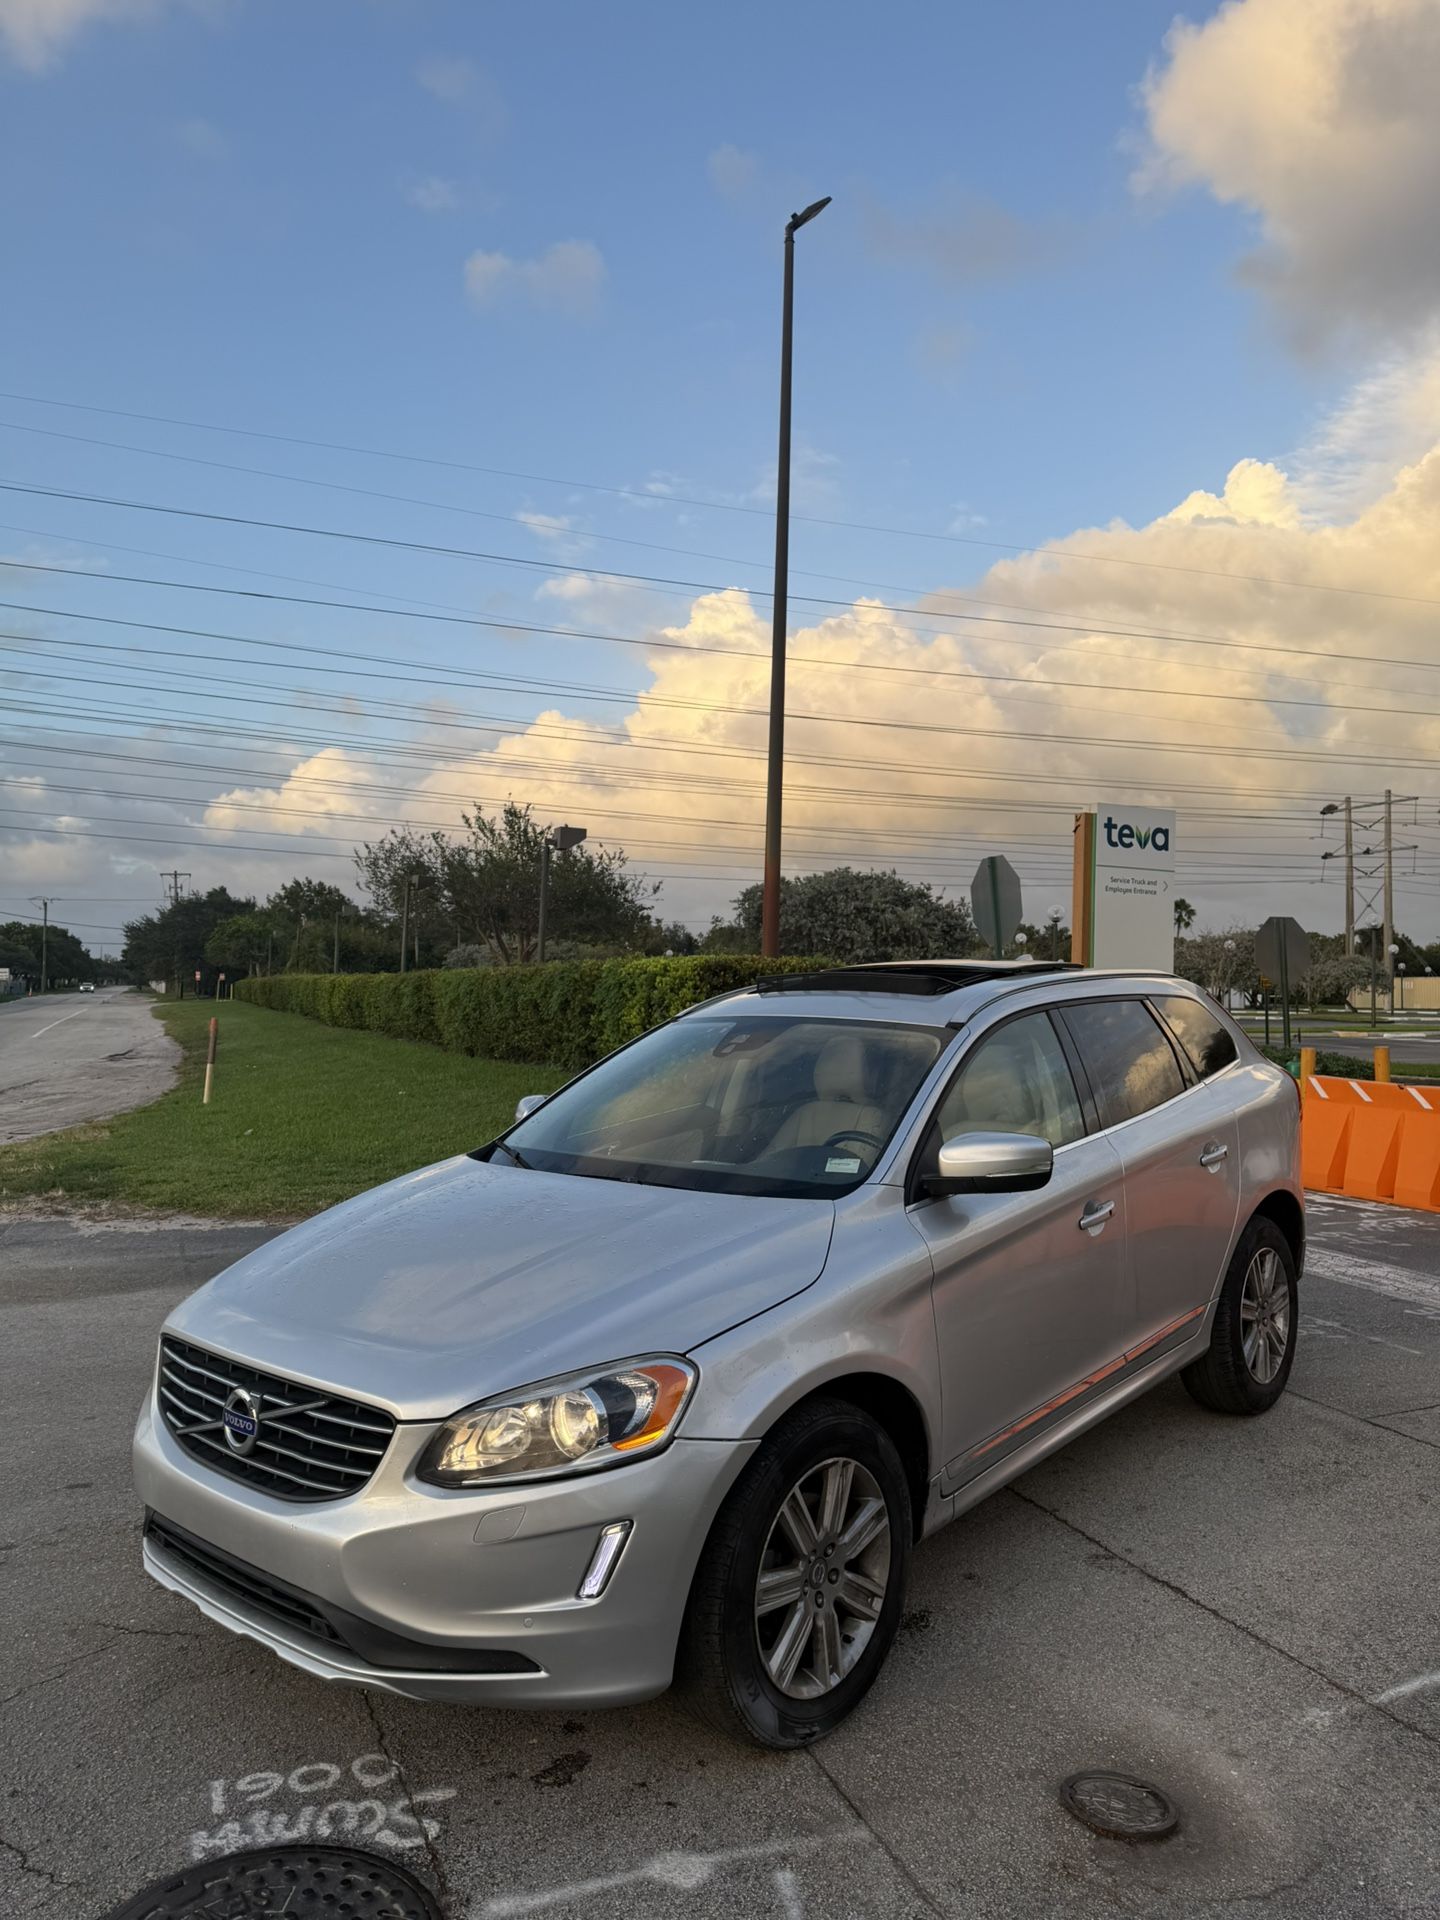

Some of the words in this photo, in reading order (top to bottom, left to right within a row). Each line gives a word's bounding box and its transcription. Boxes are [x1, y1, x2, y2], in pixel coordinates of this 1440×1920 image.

[1103, 816, 1169, 852] teva
[1110, 876, 1130, 885] Service
[1131, 877, 1146, 886] Truck
[1105, 884, 1132, 895] Employee
[1133, 887, 1157, 896] Entrance
[224, 1412, 253, 1431] VOLVO
